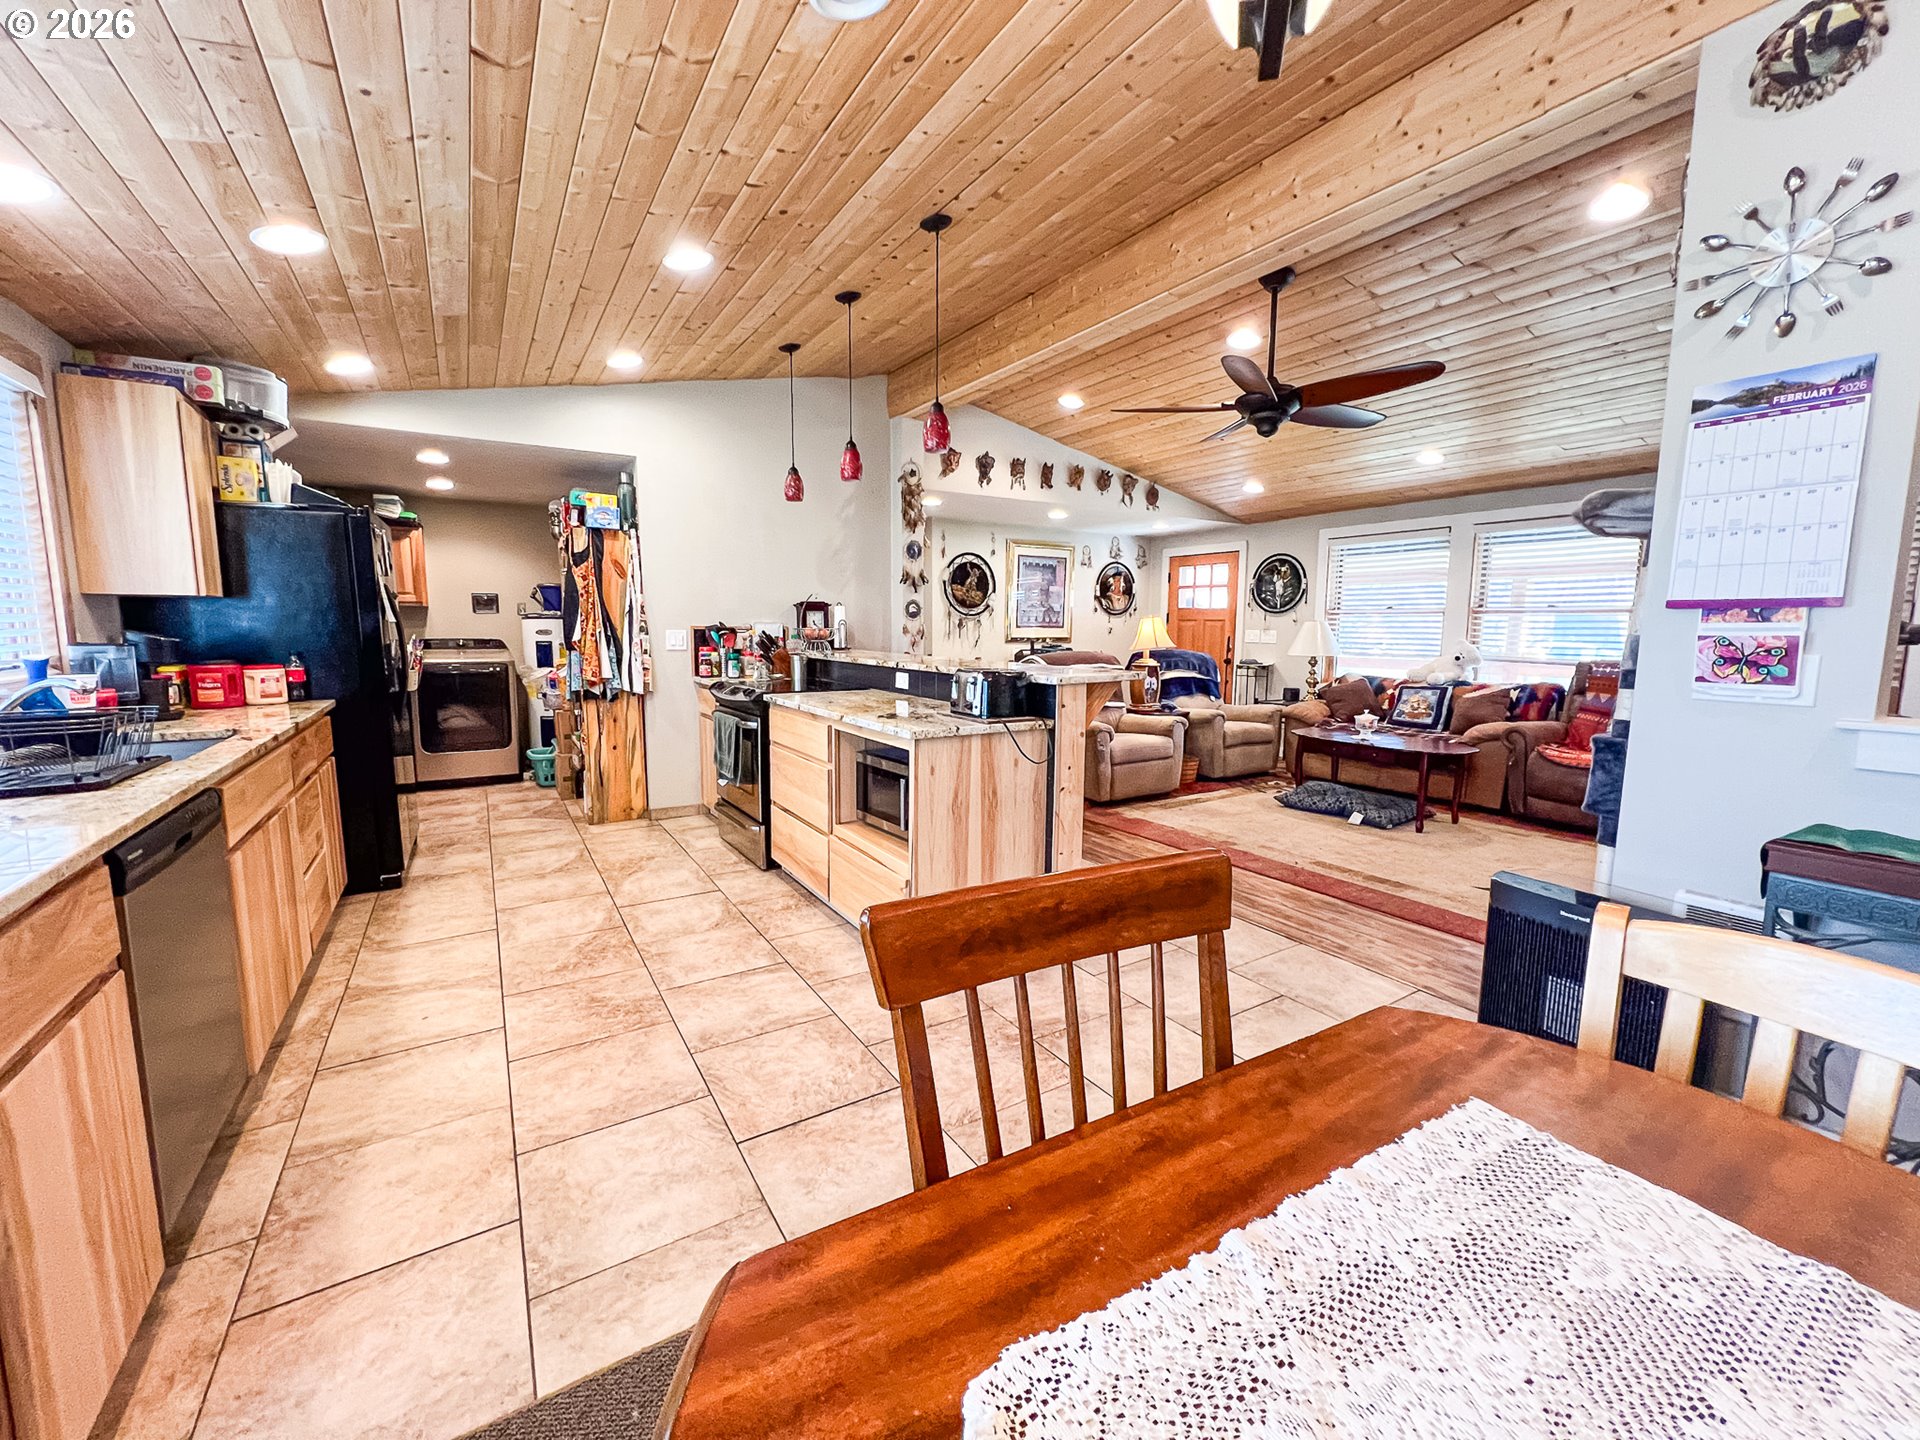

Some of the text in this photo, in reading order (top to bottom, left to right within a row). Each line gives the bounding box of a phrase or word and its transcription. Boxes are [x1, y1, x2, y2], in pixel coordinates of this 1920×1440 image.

[132, 362, 193, 376] PARCHEMIN
[1772, 380, 1868, 404] FEBRUARY 2026
[221, 464, 233, 493] Splenda
[1560, 910, 1591, 923] Honeywell
